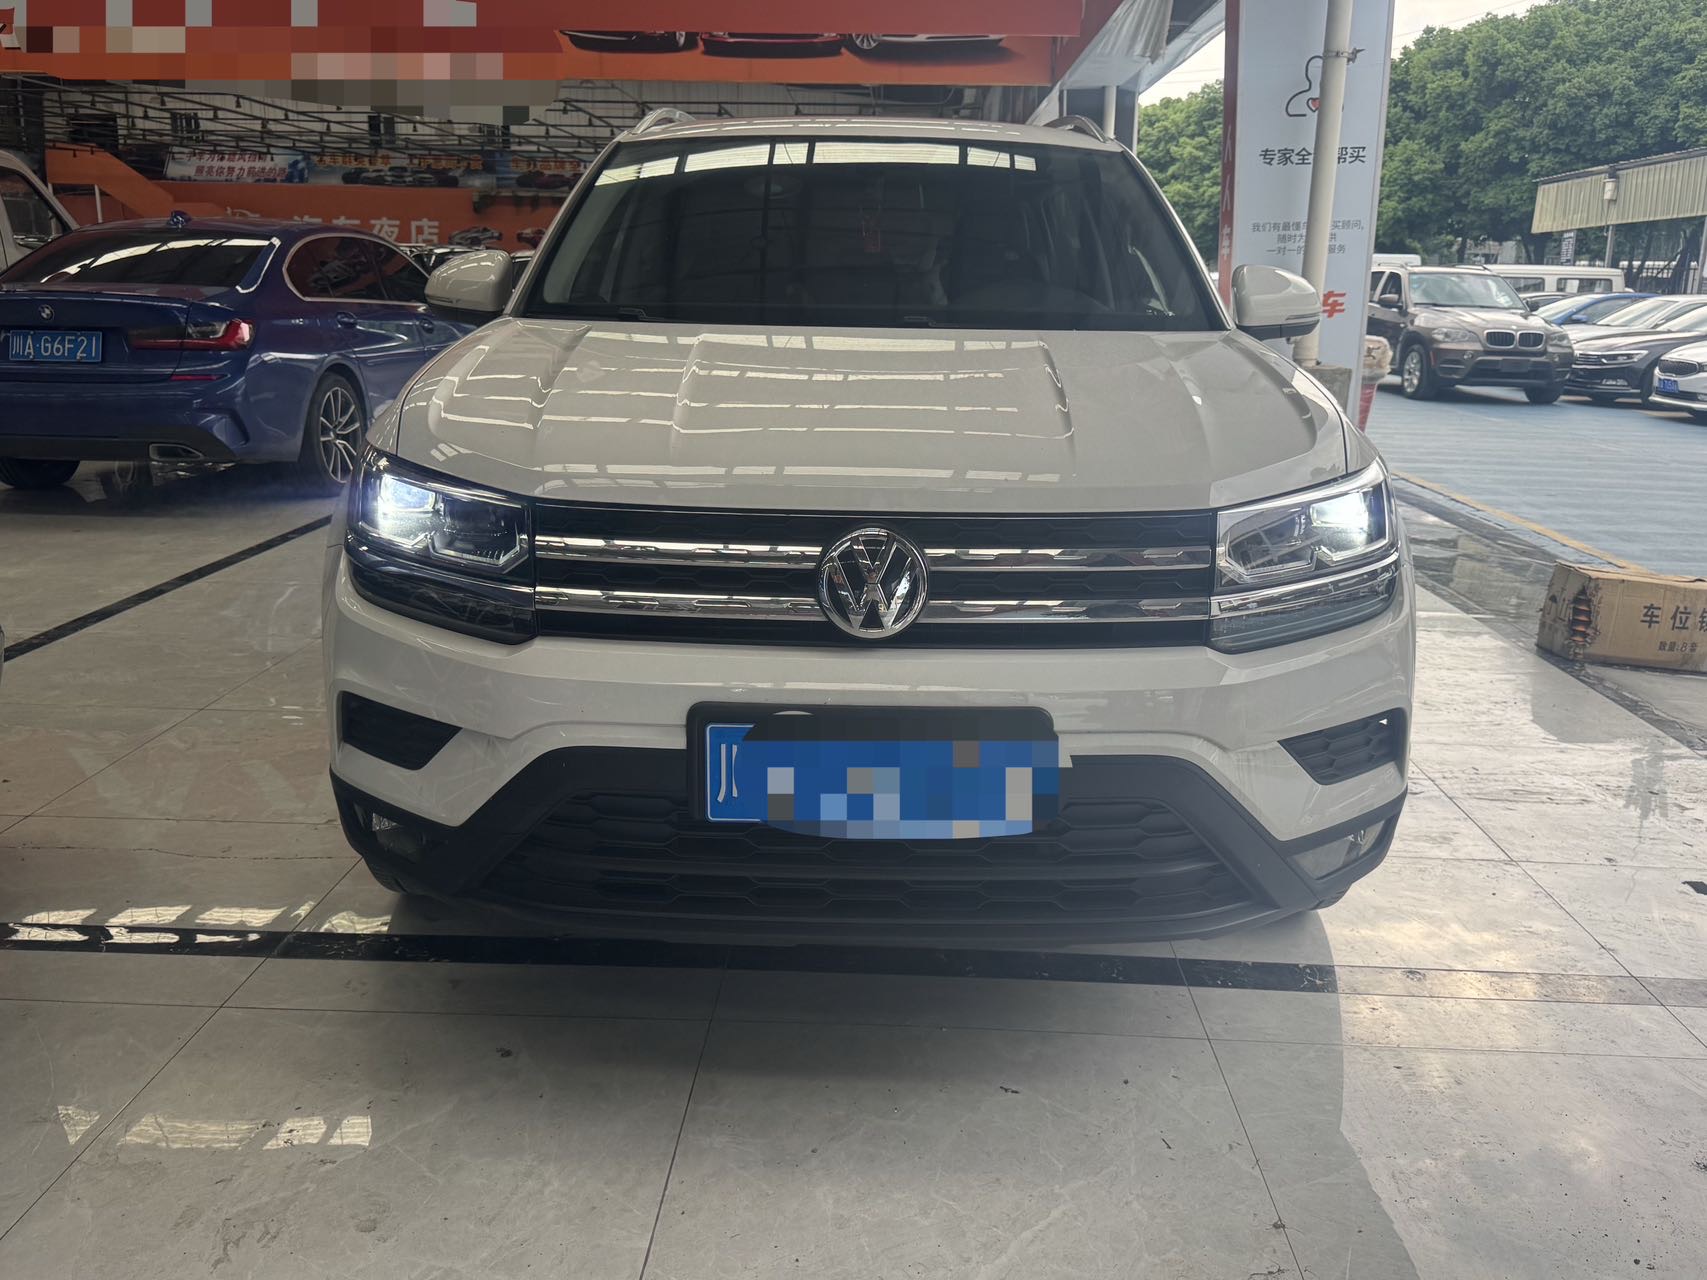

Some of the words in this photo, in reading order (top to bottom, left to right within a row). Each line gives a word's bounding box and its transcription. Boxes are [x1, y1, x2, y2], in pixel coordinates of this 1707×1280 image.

[1259, 146, 1367, 167] 专家全帮买
